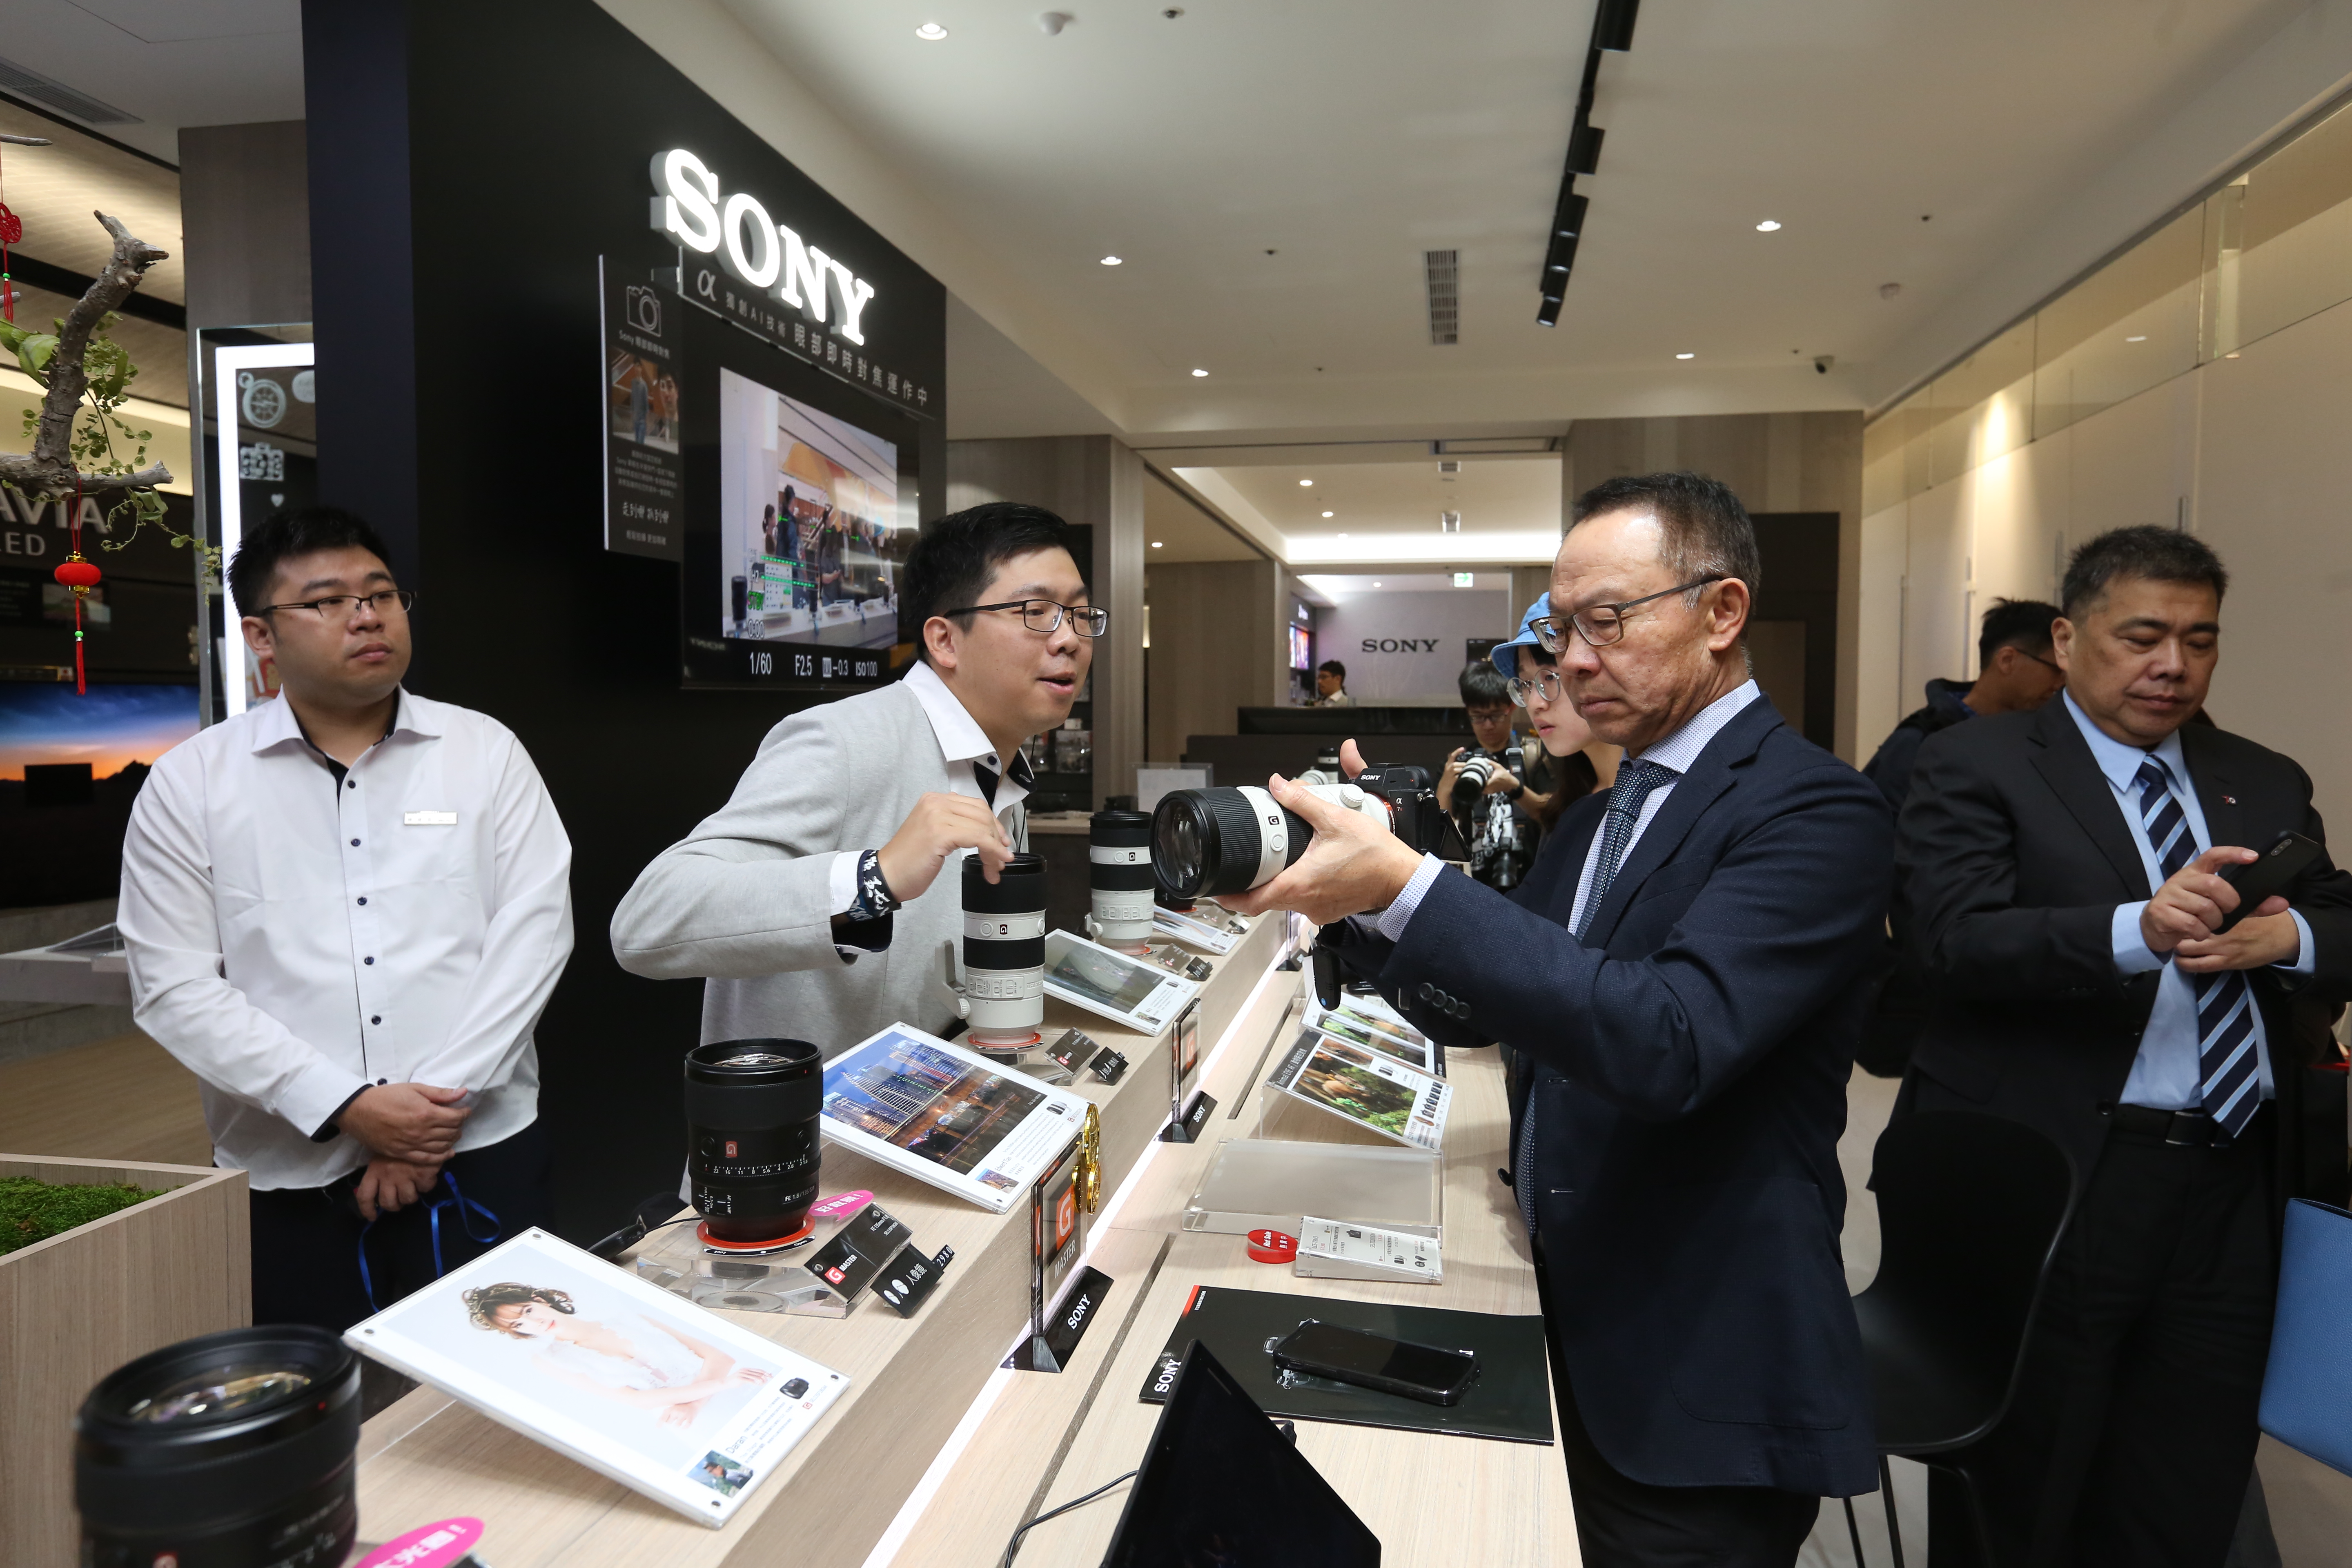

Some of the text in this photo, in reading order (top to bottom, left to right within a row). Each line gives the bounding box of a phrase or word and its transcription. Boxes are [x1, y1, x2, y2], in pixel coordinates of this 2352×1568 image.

[665, 149, 874, 346] SONY
[0, 532, 46, 556] ED
[747, 618, 765, 639] 0:00
[1362, 639, 1439, 653] SONY
[750, 652, 772, 675] 1/60
[795, 654, 812, 676] F2.5
[1193, 1105, 1206, 1123] SONY
[727, 1144, 735, 1154] G
[1059, 1192, 1071, 1237] G
[1263, 1231, 1272, 1247] Hot Sale
[838, 1254, 858, 1272] MASTER
[933, 1246, 953, 1267] 2980
[1054, 1239, 1076, 1279] MASTER
[1067, 1293, 1091, 1330] SONY
[1154, 1359, 1181, 1393] SONY
